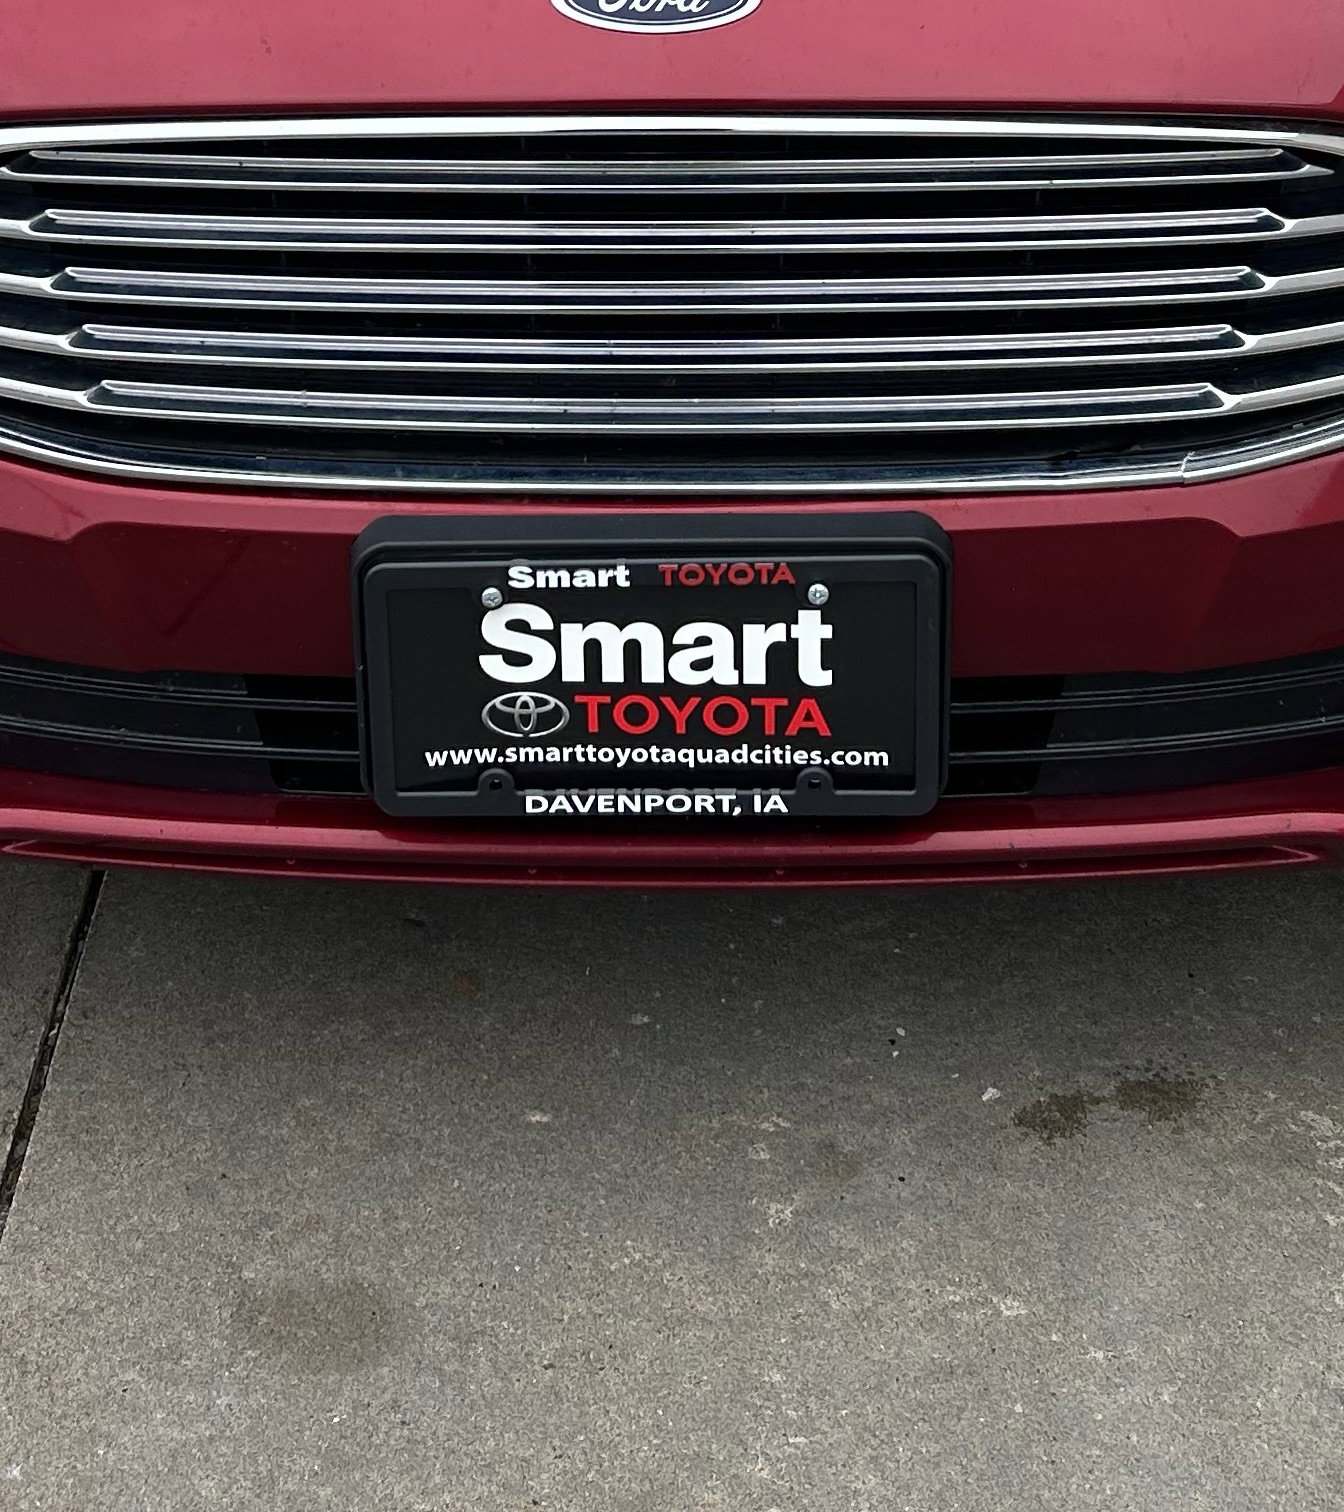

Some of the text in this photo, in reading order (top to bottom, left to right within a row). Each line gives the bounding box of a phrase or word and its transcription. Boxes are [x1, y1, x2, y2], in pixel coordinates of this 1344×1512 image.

[507, 562, 797, 589] Smart TOYOTA
[478, 601, 833, 687] Smart
[574, 694, 832, 737] TOYOTA
[424, 743, 889, 769] www.smarttoyotaquadcities.com
[524, 790, 789, 817] DAVENPORT, IA
